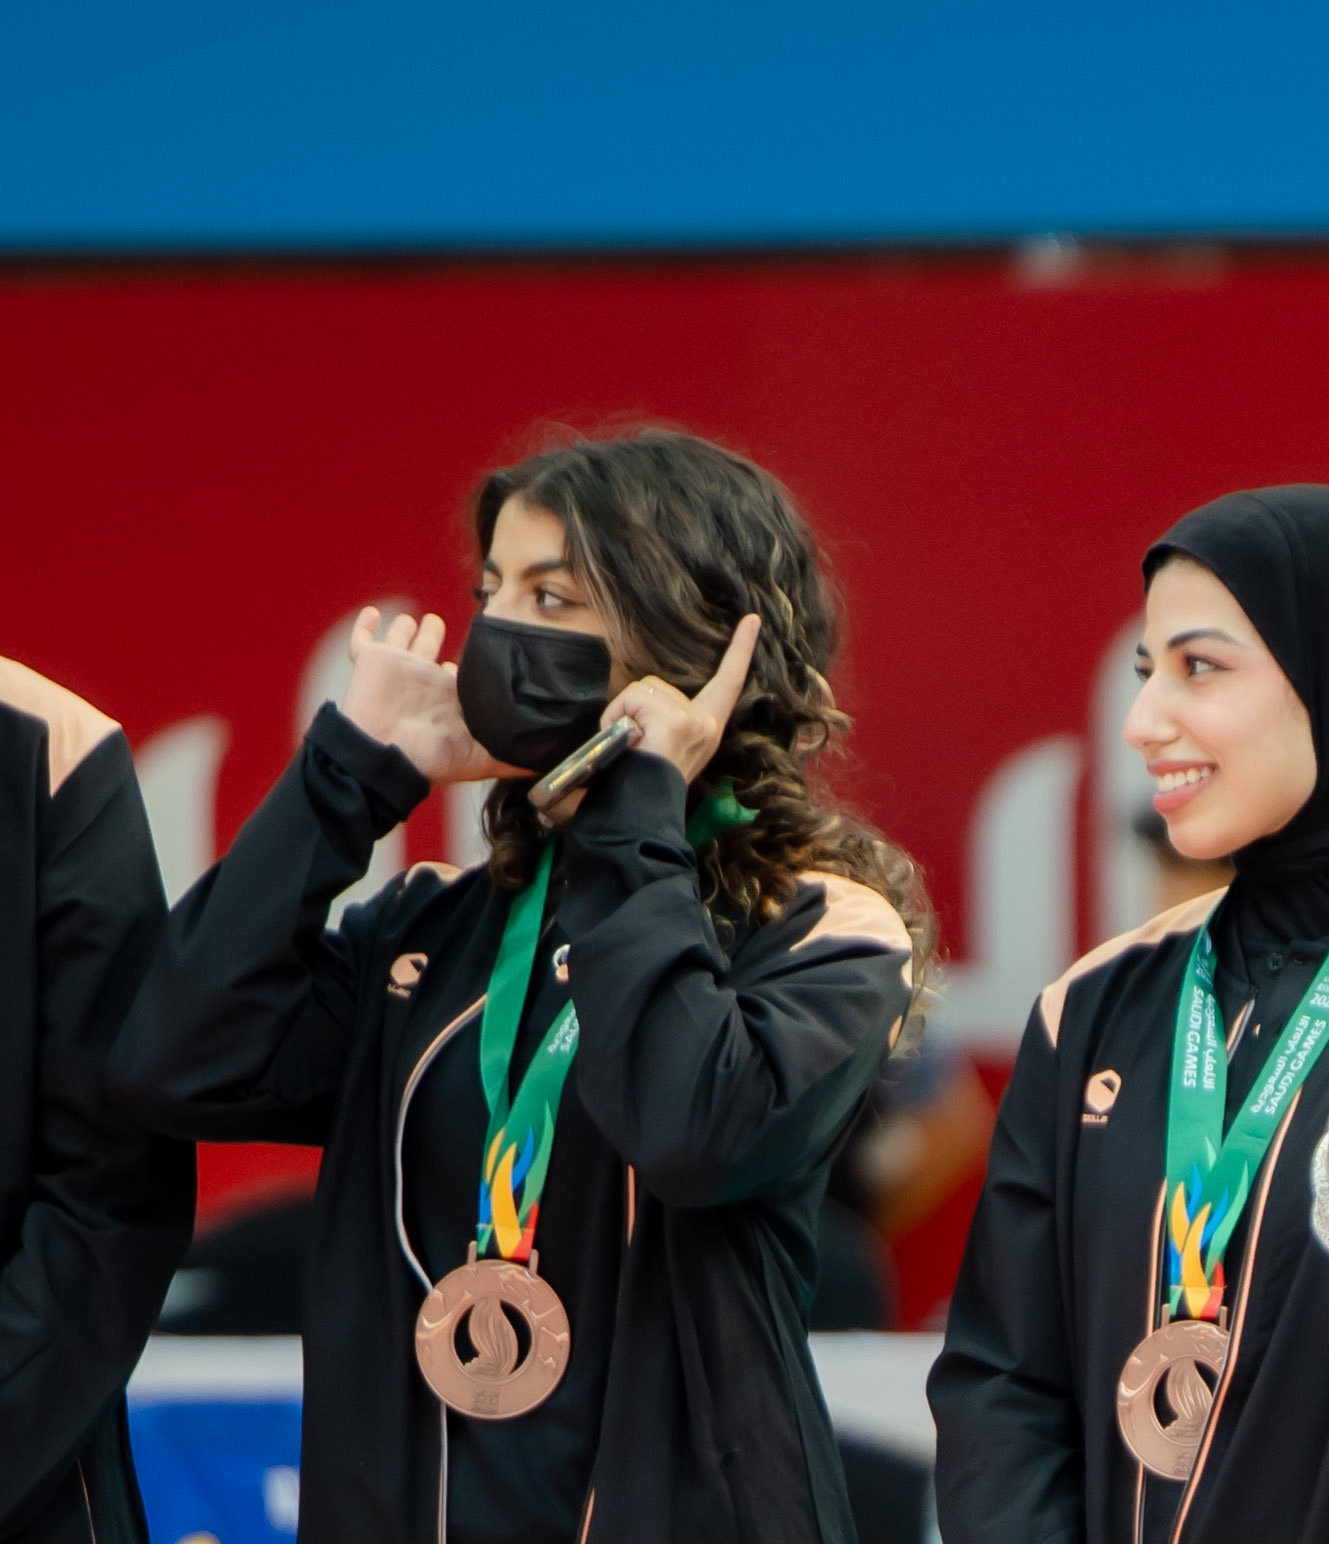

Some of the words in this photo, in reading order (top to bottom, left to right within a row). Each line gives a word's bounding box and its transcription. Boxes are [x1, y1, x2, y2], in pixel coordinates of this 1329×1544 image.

[1190, 986, 1204, 1030] SAUDI
[1183, 1031, 1201, 1088] GAMES
[1264, 1071, 1296, 1115] SAUDI
[1290, 1019, 1327, 1071] GAMES
